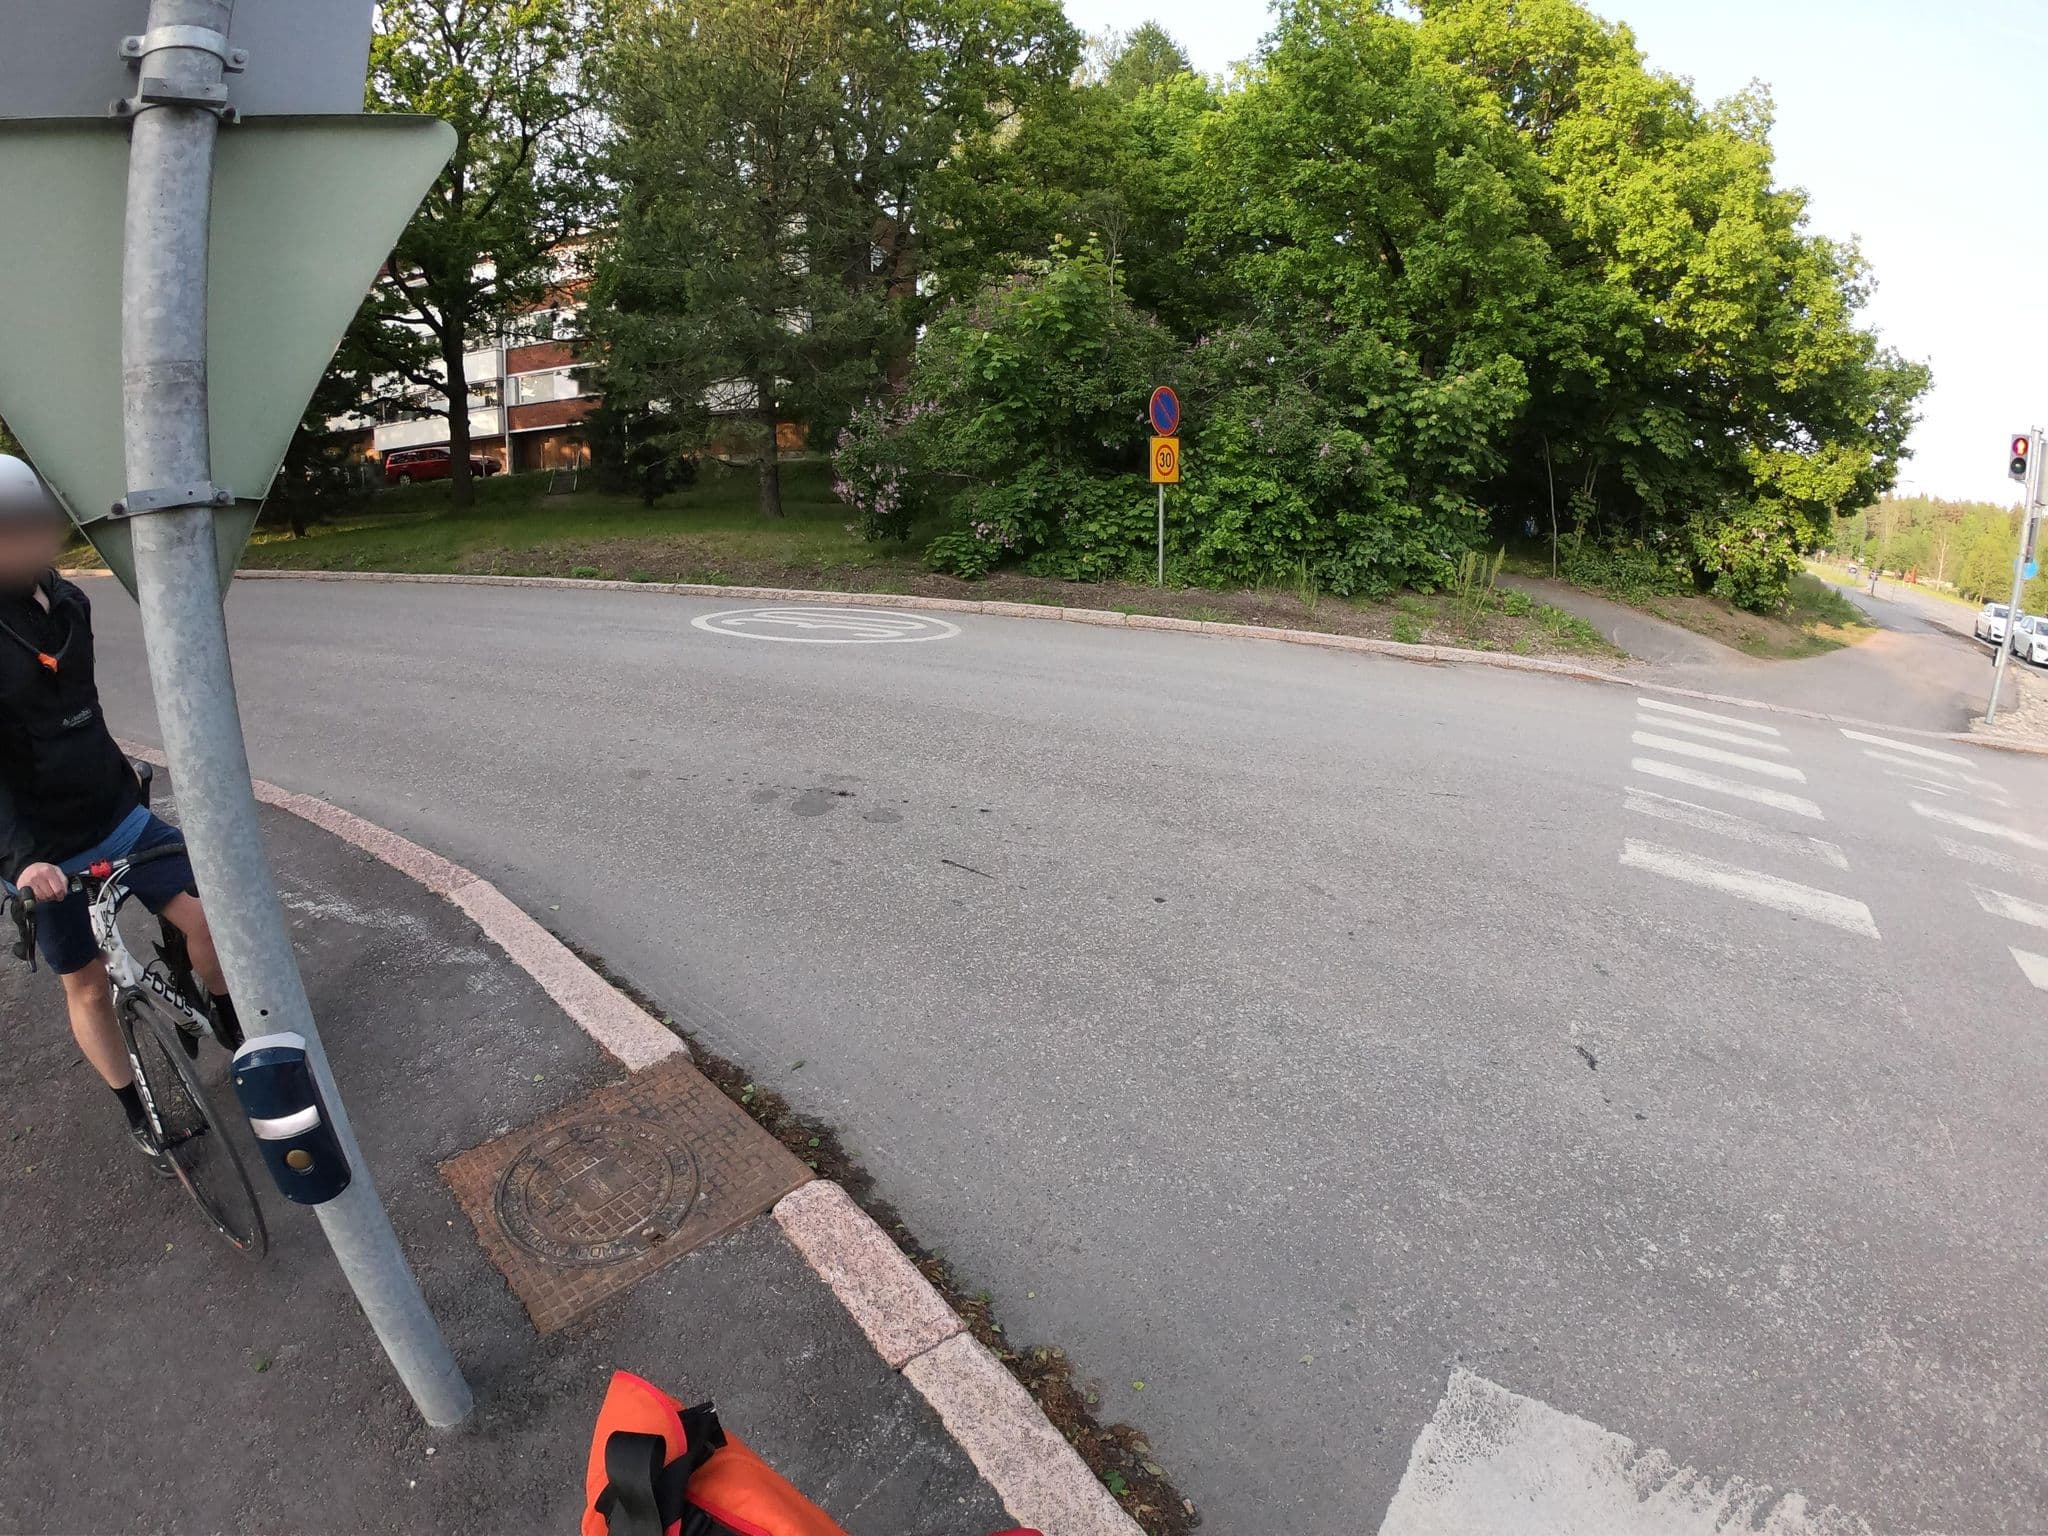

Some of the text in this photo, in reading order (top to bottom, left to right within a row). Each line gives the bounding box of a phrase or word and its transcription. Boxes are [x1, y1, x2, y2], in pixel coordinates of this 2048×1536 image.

[1159, 452, 1172, 468] 30
[721, 611, 928, 638] 30
[141, 969, 193, 1018] FOCUS
